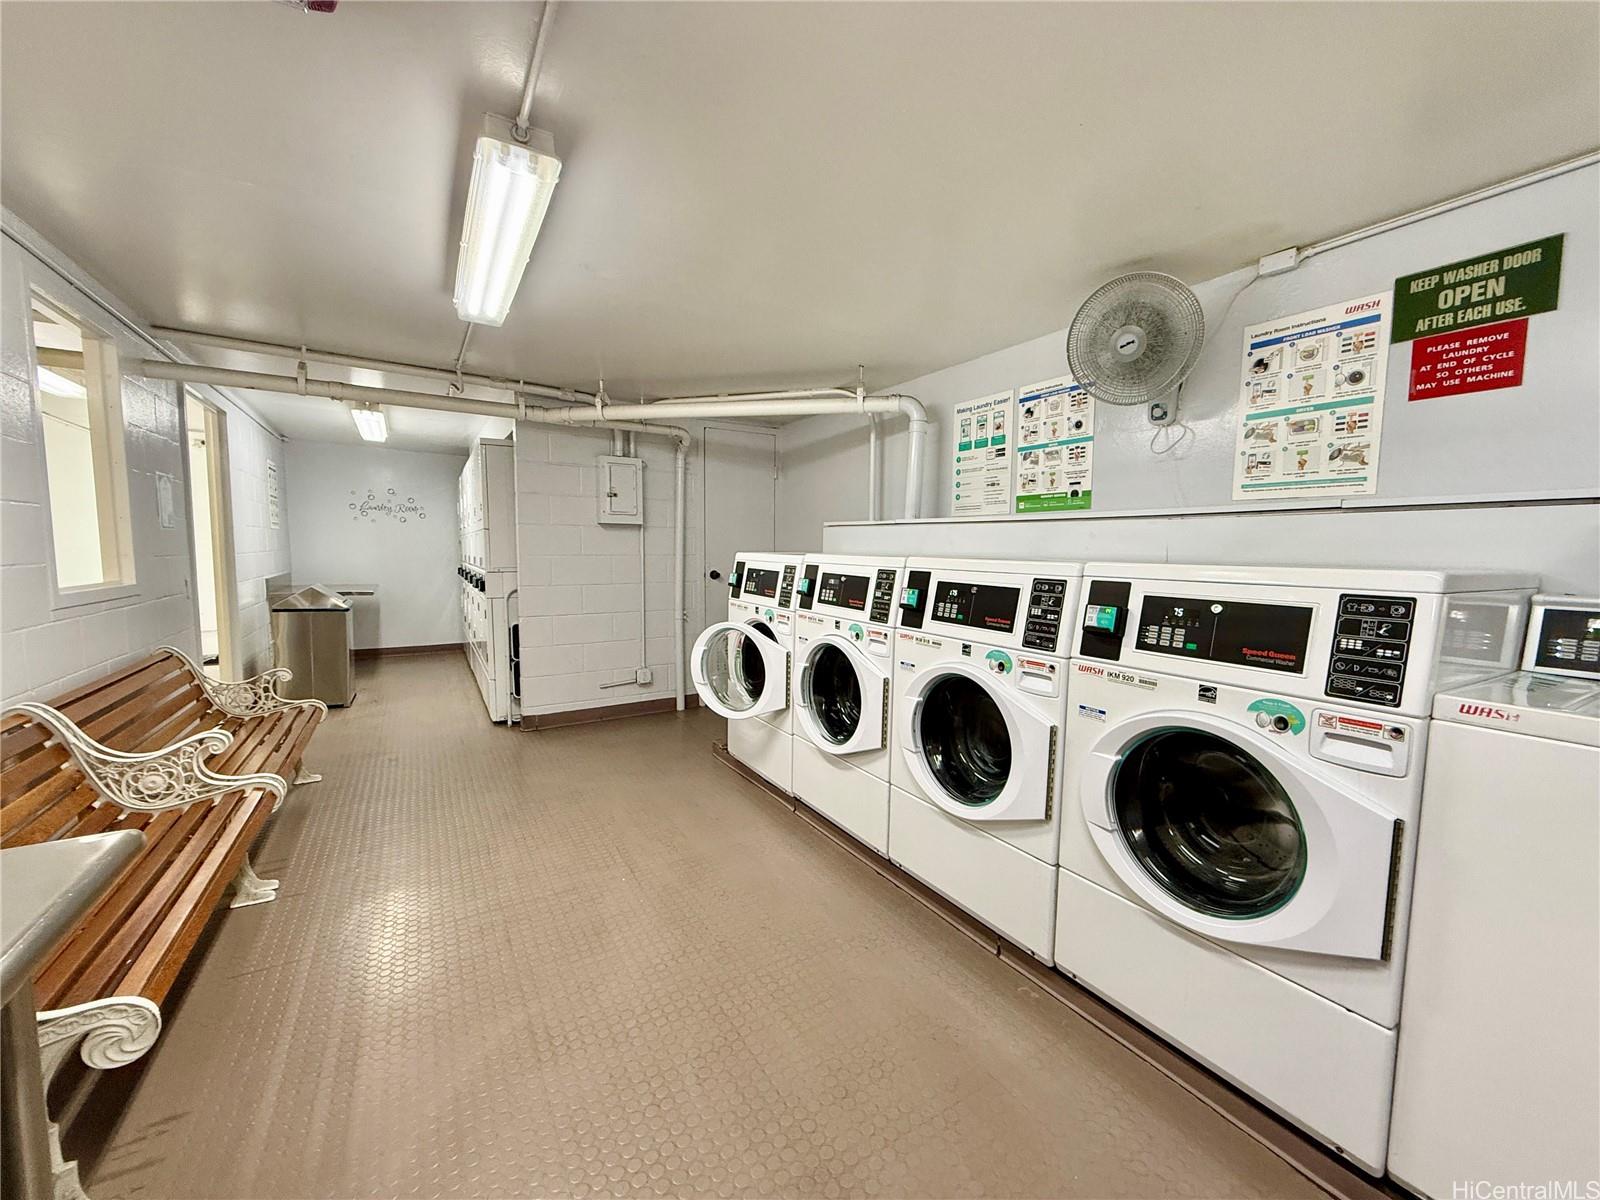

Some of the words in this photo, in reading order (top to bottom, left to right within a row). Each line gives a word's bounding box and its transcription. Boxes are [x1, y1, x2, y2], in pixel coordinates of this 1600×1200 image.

[1410, 274, 1440, 294] KEEP
[1443, 258, 1500, 286] WASHER
[1502, 247, 1543, 271] DOOR
[1437, 275, 1507, 310] OPEN
[1344, 299, 1382, 315] WASH
[1415, 312, 1454, 333] AFTER
[1456, 304, 1492, 324] EACH
[1495, 296, 1527, 315] USE.
[1250, 329, 1273, 339] Laundry
[1274, 325, 1291, 334] Room
[1291, 317, 1327, 330] Instructions
[1282, 333, 1301, 342] FRONT
[1426, 341, 1461, 353] PLEASE
[1466, 332, 1510, 346] REMOVE
[1442, 345, 1490, 360] LAUNDRY
[1419, 364, 1432, 373] AT
[1436, 359, 1457, 370] END
[1462, 357, 1477, 366] OF
[1482, 350, 1516, 362] CYCLE
[1435, 370, 1449, 379] SO
[1455, 363, 1494, 376] OTHERS
[1416, 381, 1438, 391] MAY
[1442, 377, 1461, 387] USE
[1466, 369, 1515, 384] MACHINE
[956, 405, 973, 414] Making
[973, 401, 993, 412] Laundry
[1242, 647, 1268, 657] Speed
[1268, 651, 1296, 660] Queen
[1078, 664, 1105, 676] WASH
[1121, 674, 1135, 683] 920
